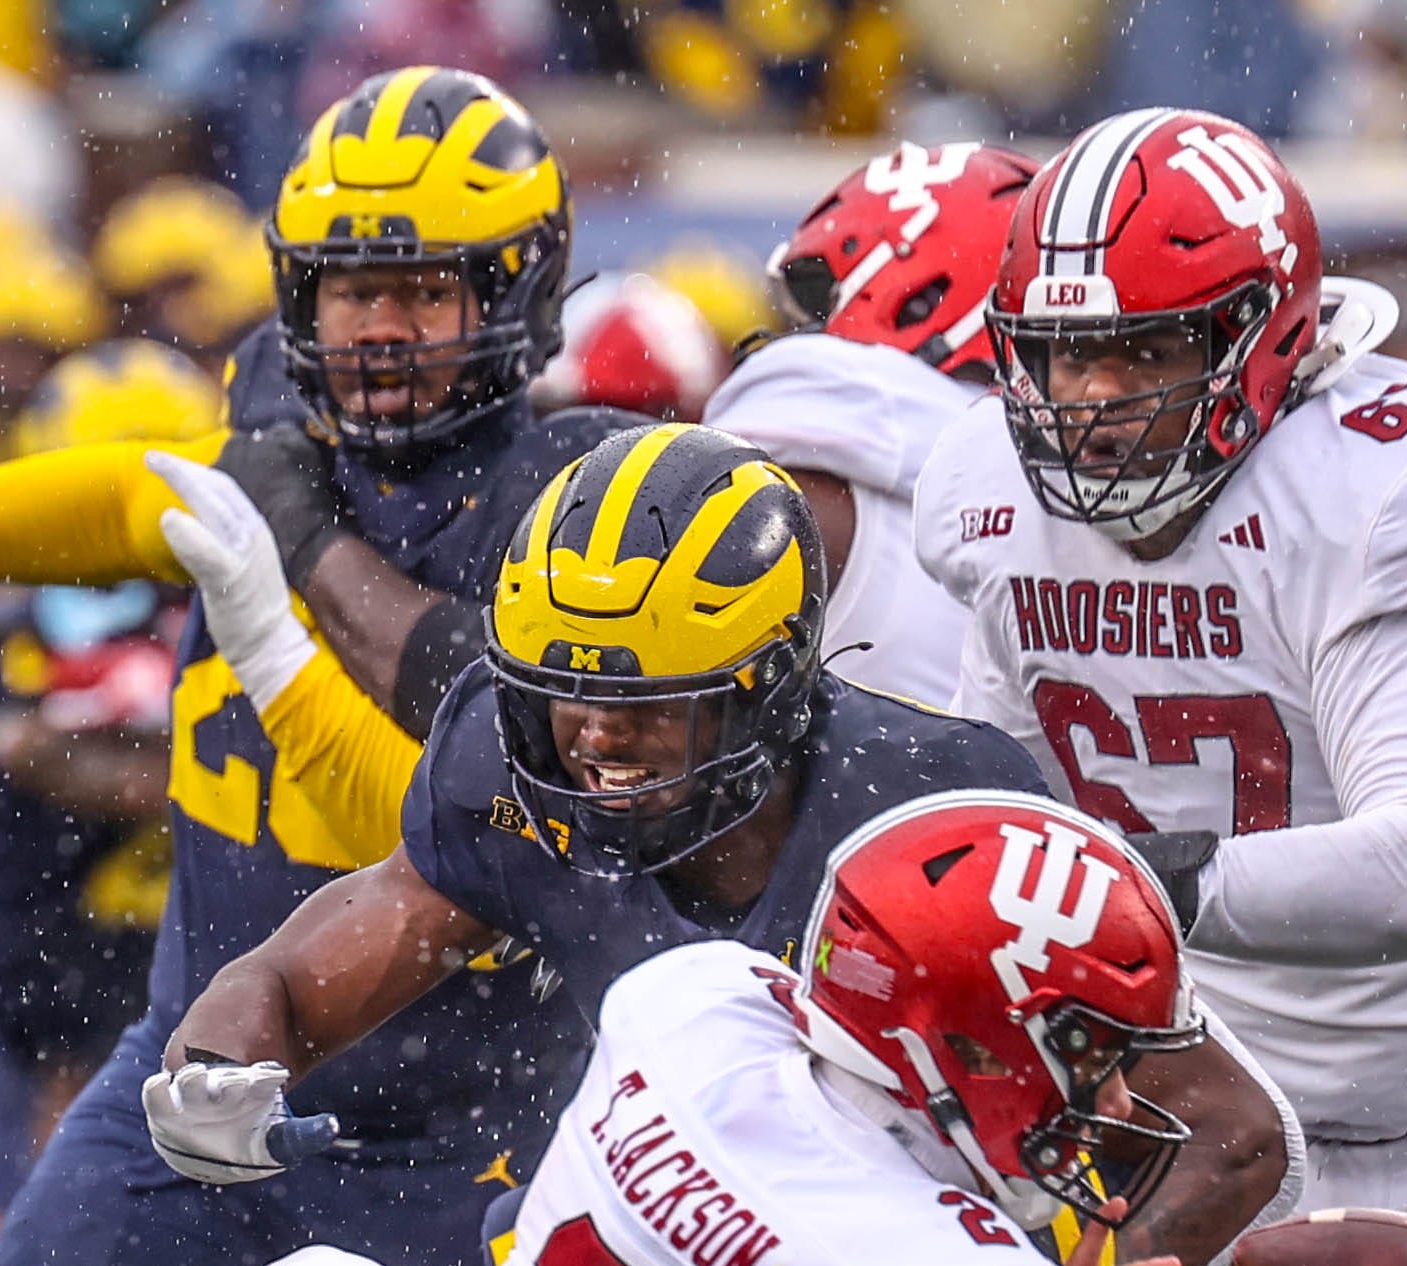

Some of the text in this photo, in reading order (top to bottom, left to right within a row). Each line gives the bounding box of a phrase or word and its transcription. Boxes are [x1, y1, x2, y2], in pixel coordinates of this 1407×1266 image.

[1046, 283, 1086, 305] LEO
[1009, 577, 1243, 659] HOOSIERS
[570, 646, 601, 672] M
[938, 1191, 1021, 1247] 2
